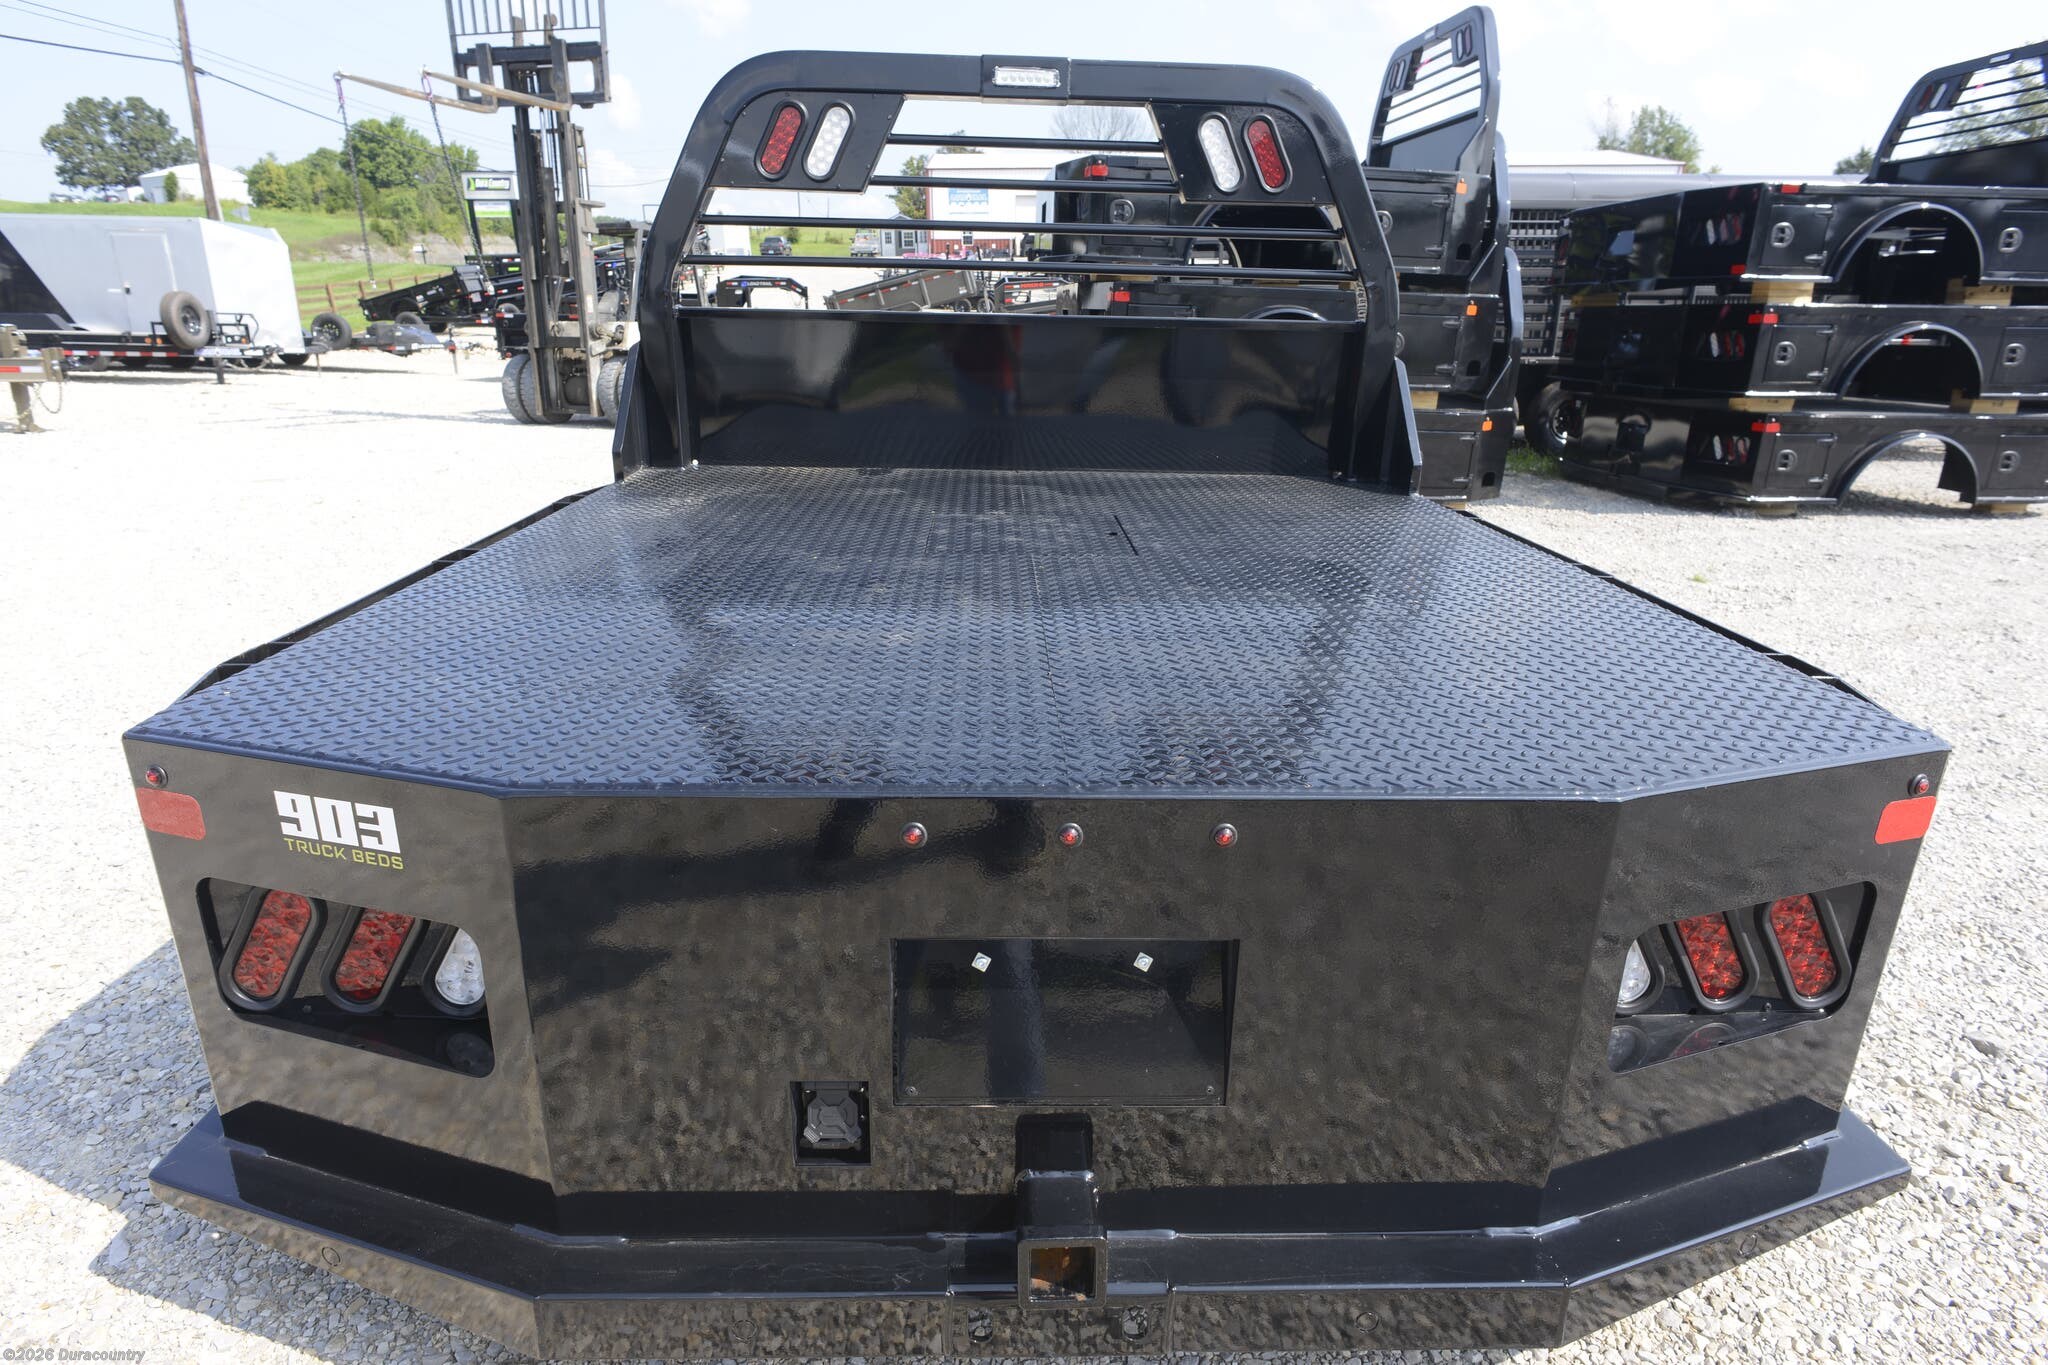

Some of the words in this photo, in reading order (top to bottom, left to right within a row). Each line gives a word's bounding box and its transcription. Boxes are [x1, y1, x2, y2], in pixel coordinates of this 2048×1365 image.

[273, 790, 401, 854] 903
[283, 837, 347, 860] TRUCK
[351, 849, 404, 870] BEDS
